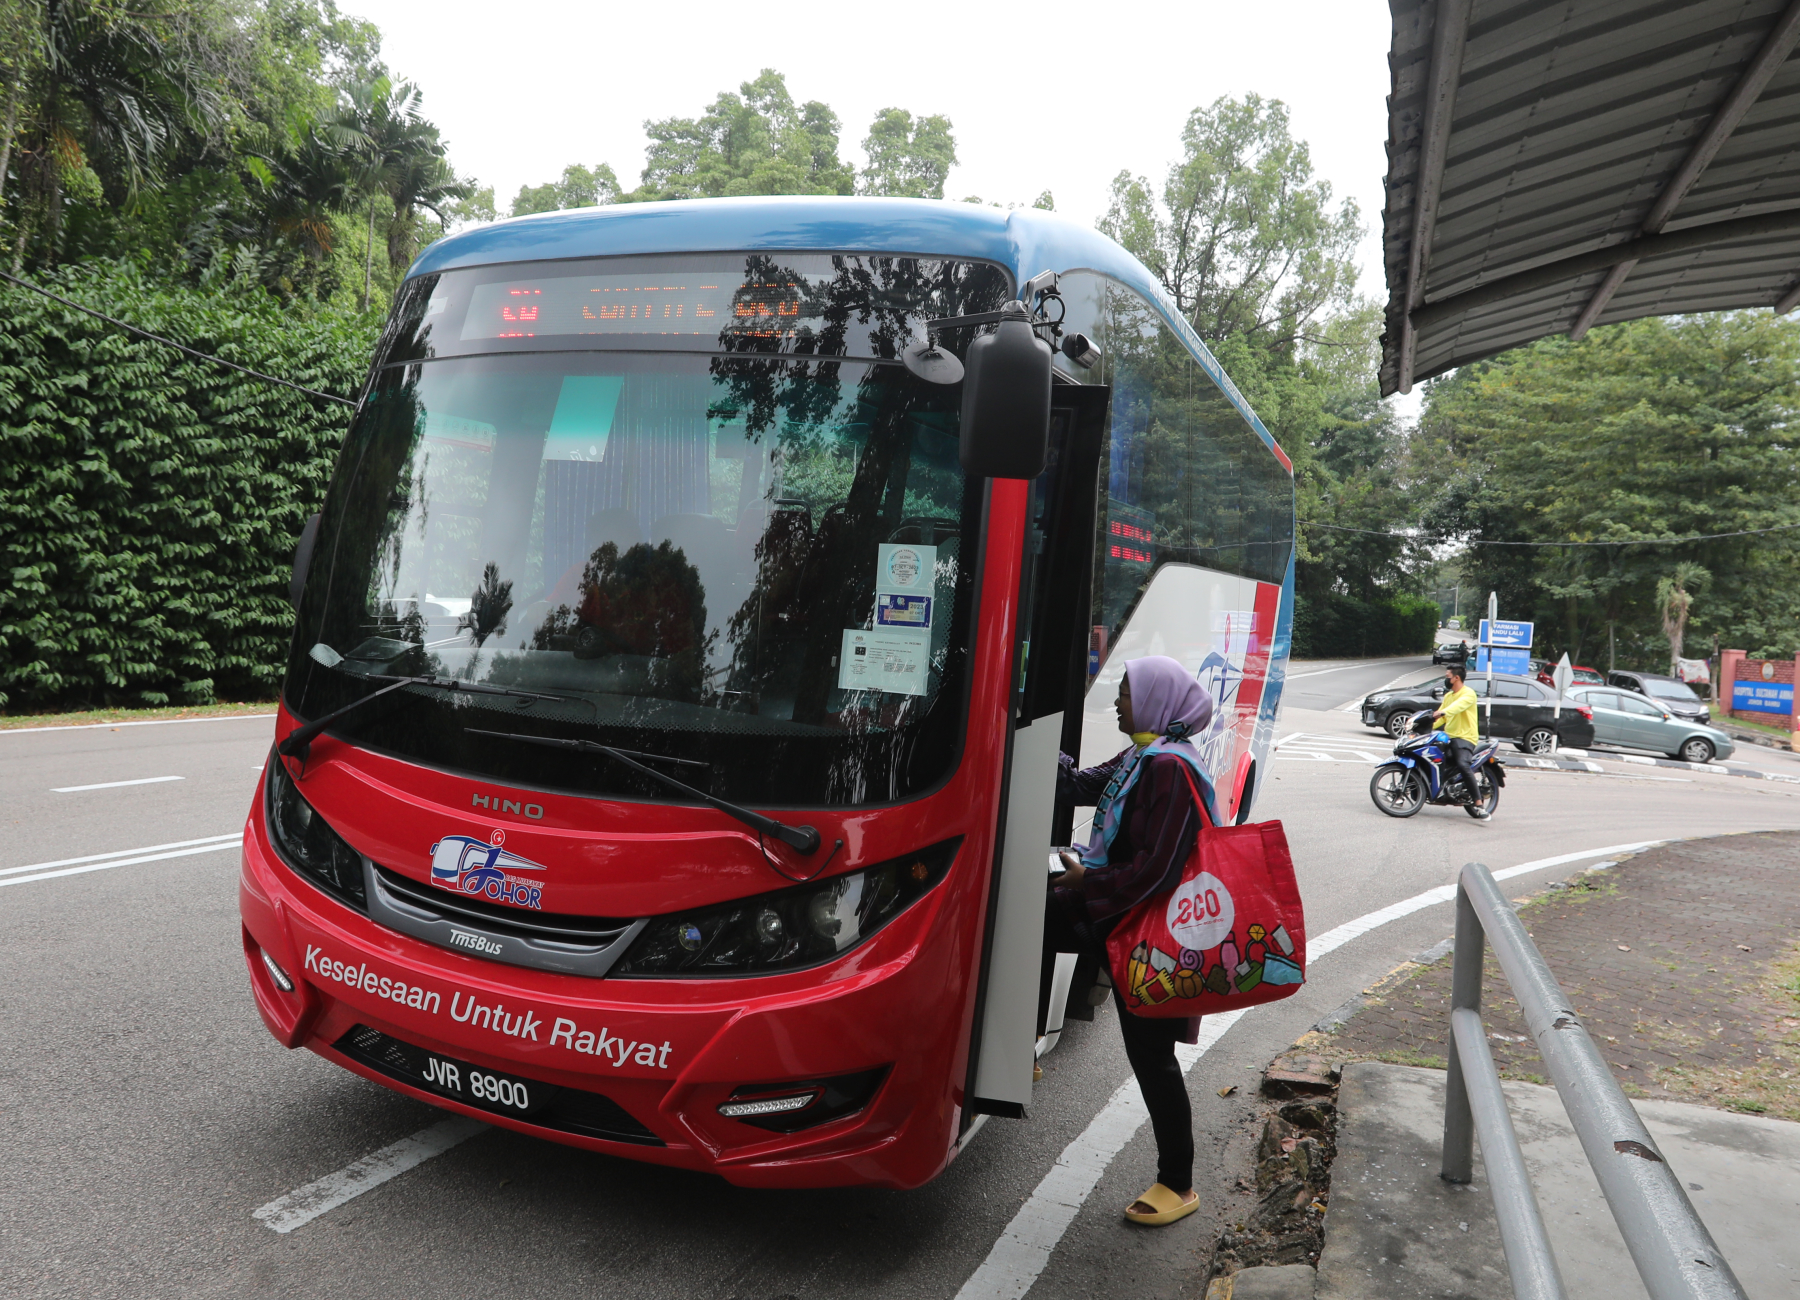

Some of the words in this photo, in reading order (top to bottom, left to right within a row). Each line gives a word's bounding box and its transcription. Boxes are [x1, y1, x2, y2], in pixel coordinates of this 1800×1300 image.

[472, 793, 544, 820] HINO
[304, 944, 441, 1015] Keselesaan
[450, 991, 543, 1042] Untuk
[549, 1017, 672, 1069] Rakyat
[422, 1057, 461, 1092] JVR
[469, 1071, 529, 1109] 8900
